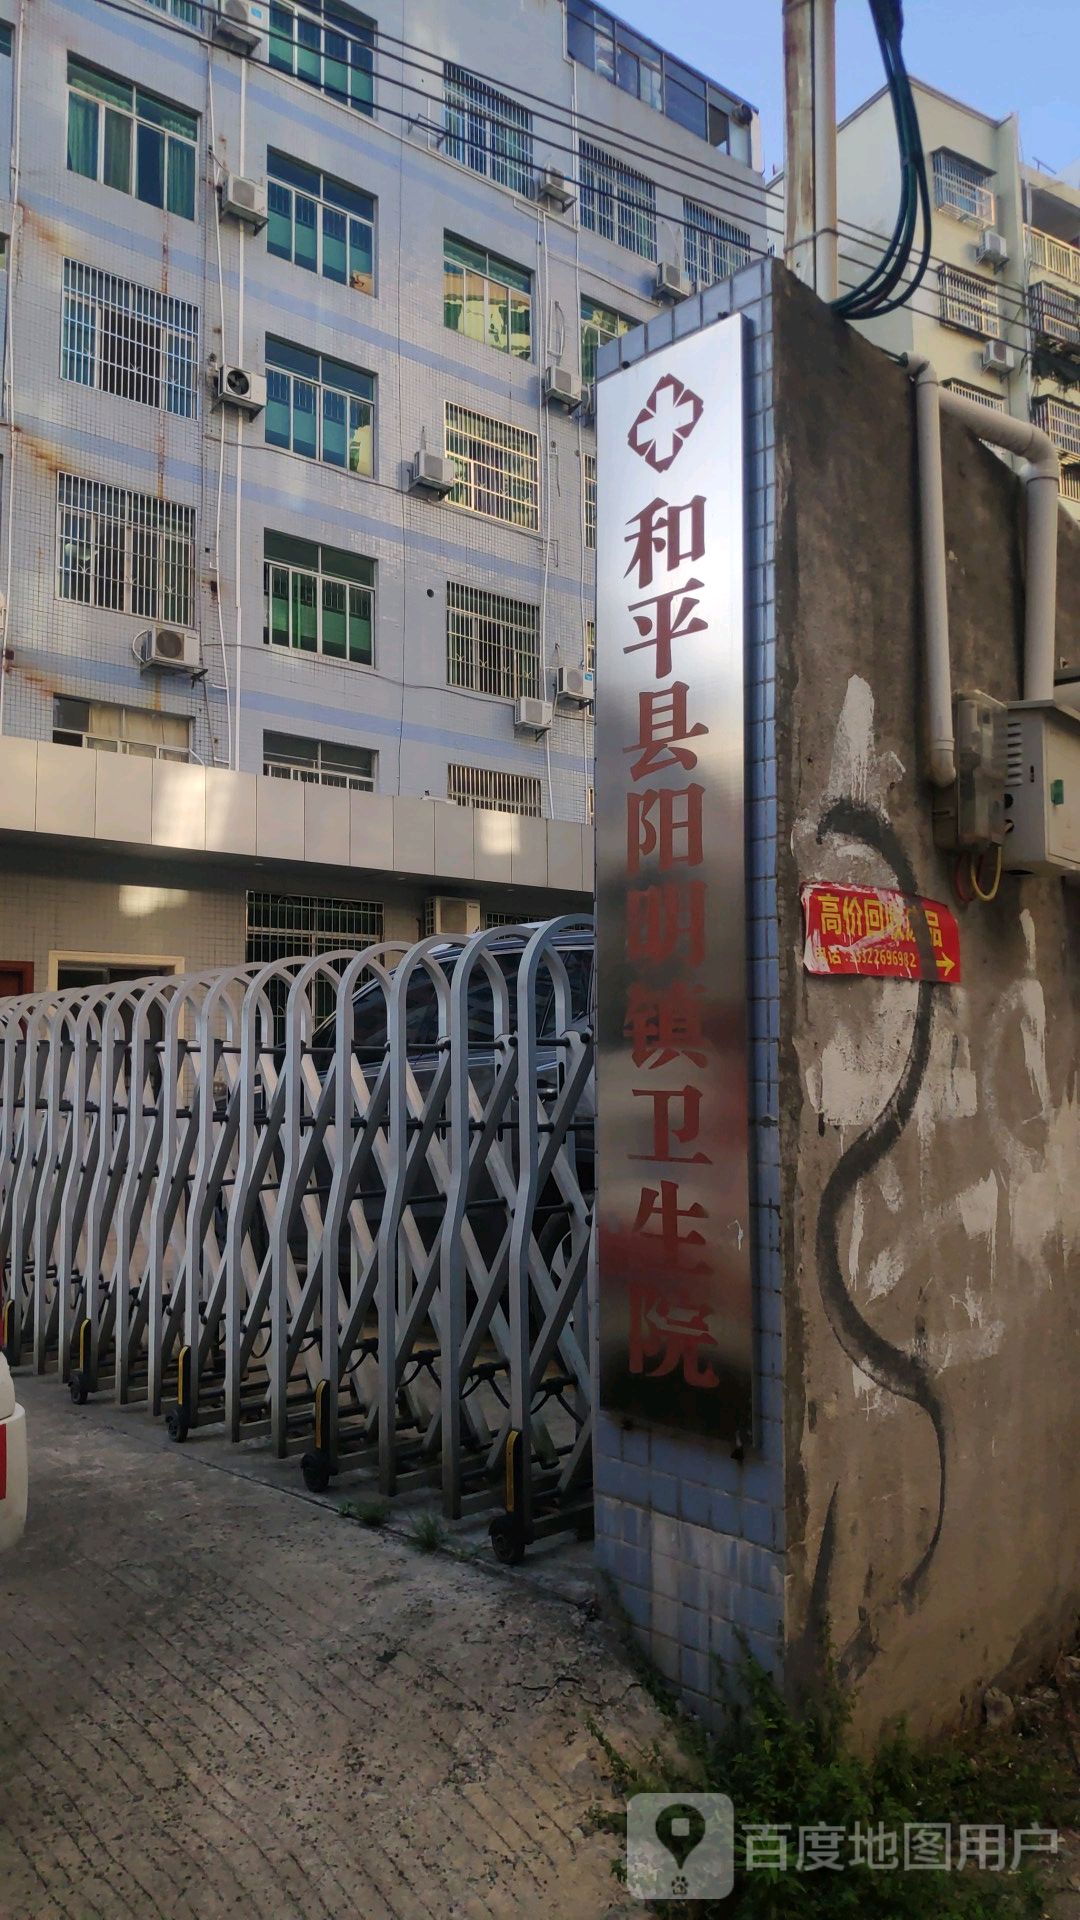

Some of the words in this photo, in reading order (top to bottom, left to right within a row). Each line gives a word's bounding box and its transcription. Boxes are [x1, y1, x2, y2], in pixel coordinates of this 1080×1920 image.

[622, 494, 720, 1388] 和平县阳明镇卫生院
